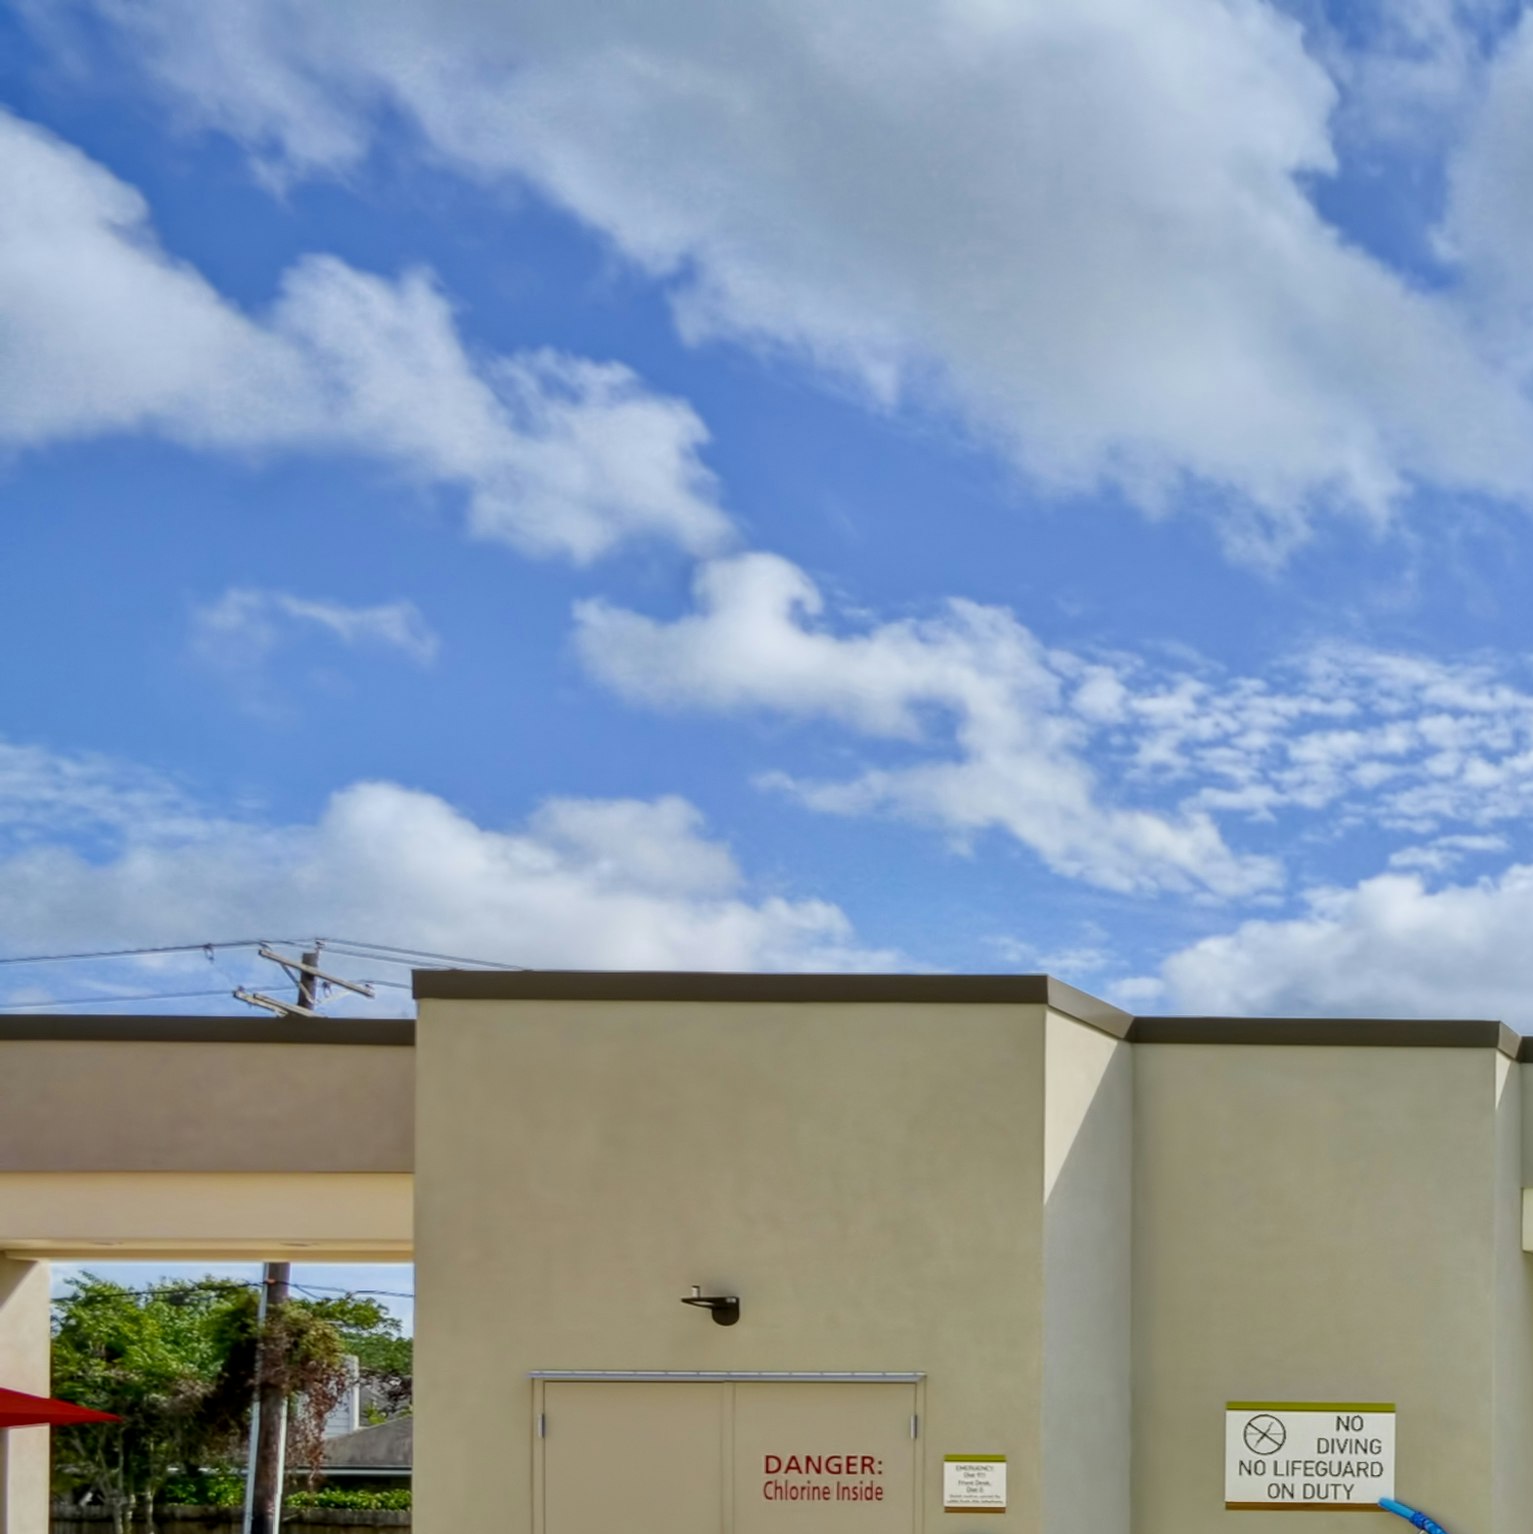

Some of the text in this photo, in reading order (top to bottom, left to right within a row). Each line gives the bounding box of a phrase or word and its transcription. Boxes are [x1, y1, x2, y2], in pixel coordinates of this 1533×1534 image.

[1335, 1414, 1364, 1432] NO
[1316, 1437, 1382, 1455] DIVING
[764, 1455, 883, 1475] DANGER:
[1238, 1459, 1384, 1478] NO LIFEGUARD
[763, 1480, 884, 1501] Chlorine Inside
[1267, 1483, 1355, 1501] ON DUTY
